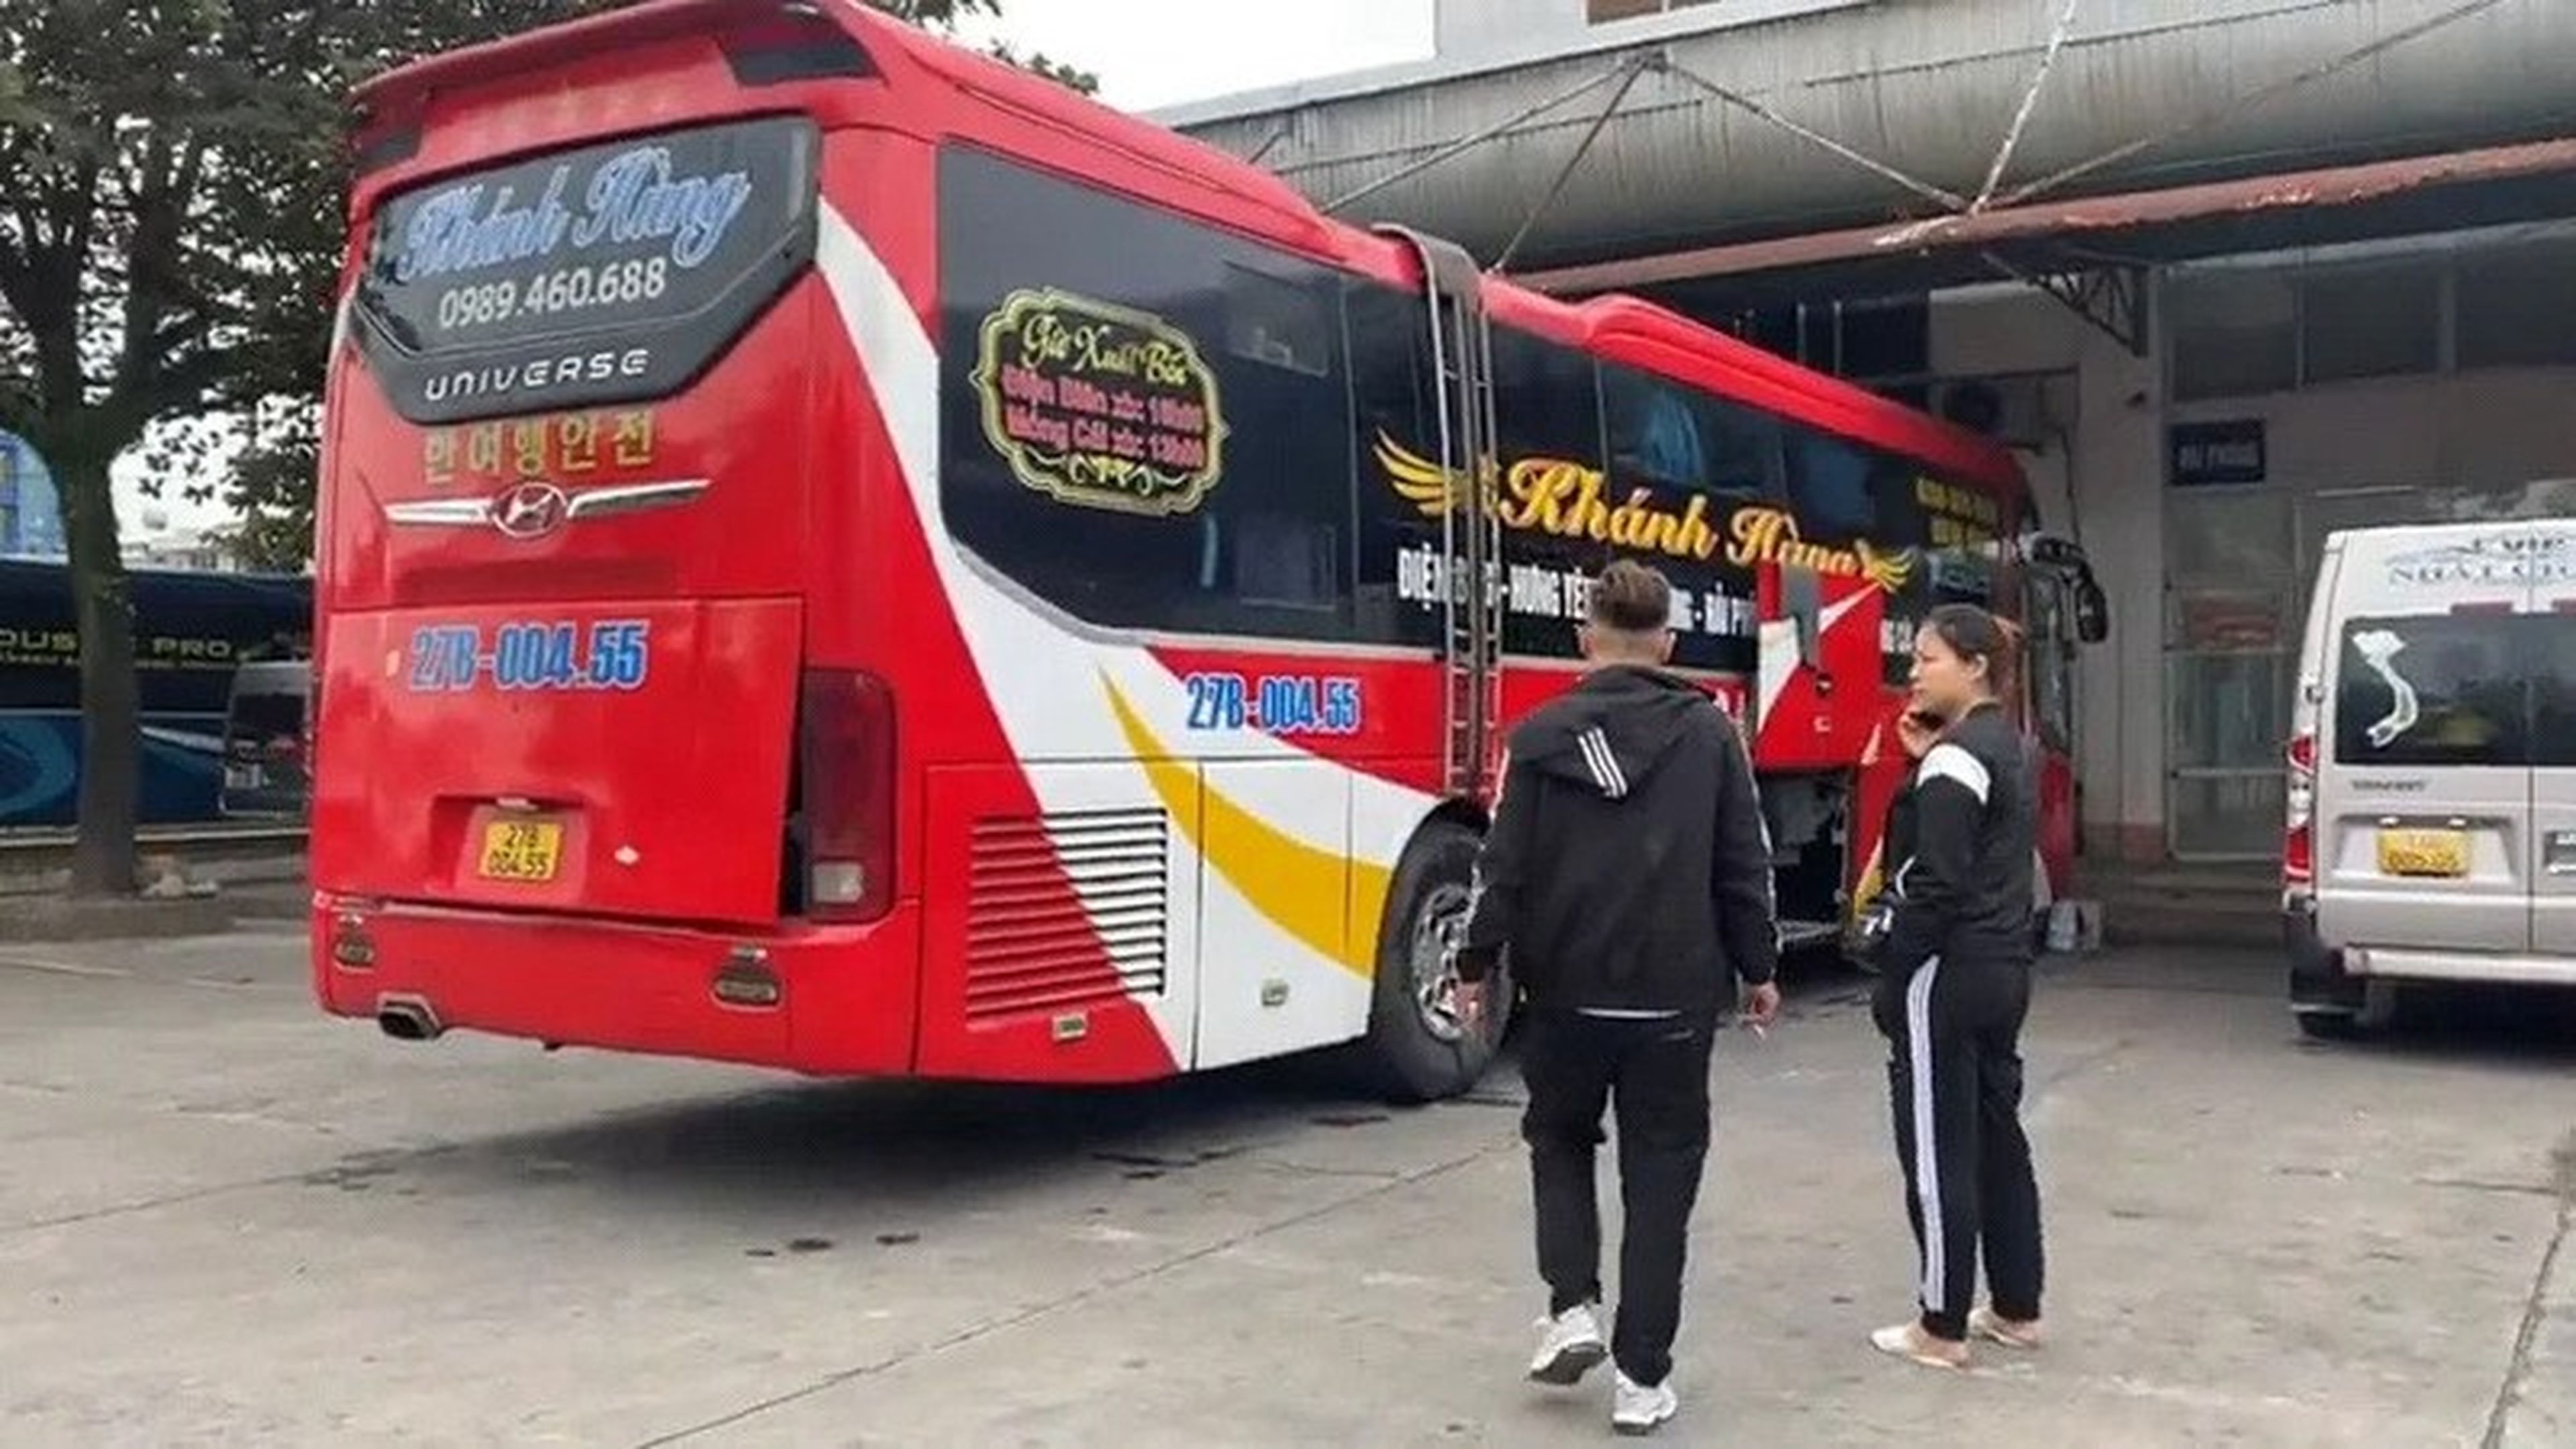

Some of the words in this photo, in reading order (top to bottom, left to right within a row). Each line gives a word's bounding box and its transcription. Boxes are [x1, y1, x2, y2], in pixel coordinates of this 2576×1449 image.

[439, 257, 667, 329] 0989.460.688
[425, 348, 649, 401] UNIVERSE
[1499, 458, 1720, 559] Khánh
[411, 619, 651, 692] 27B-004.55
[1185, 672, 1361, 733] 27B-004.55
